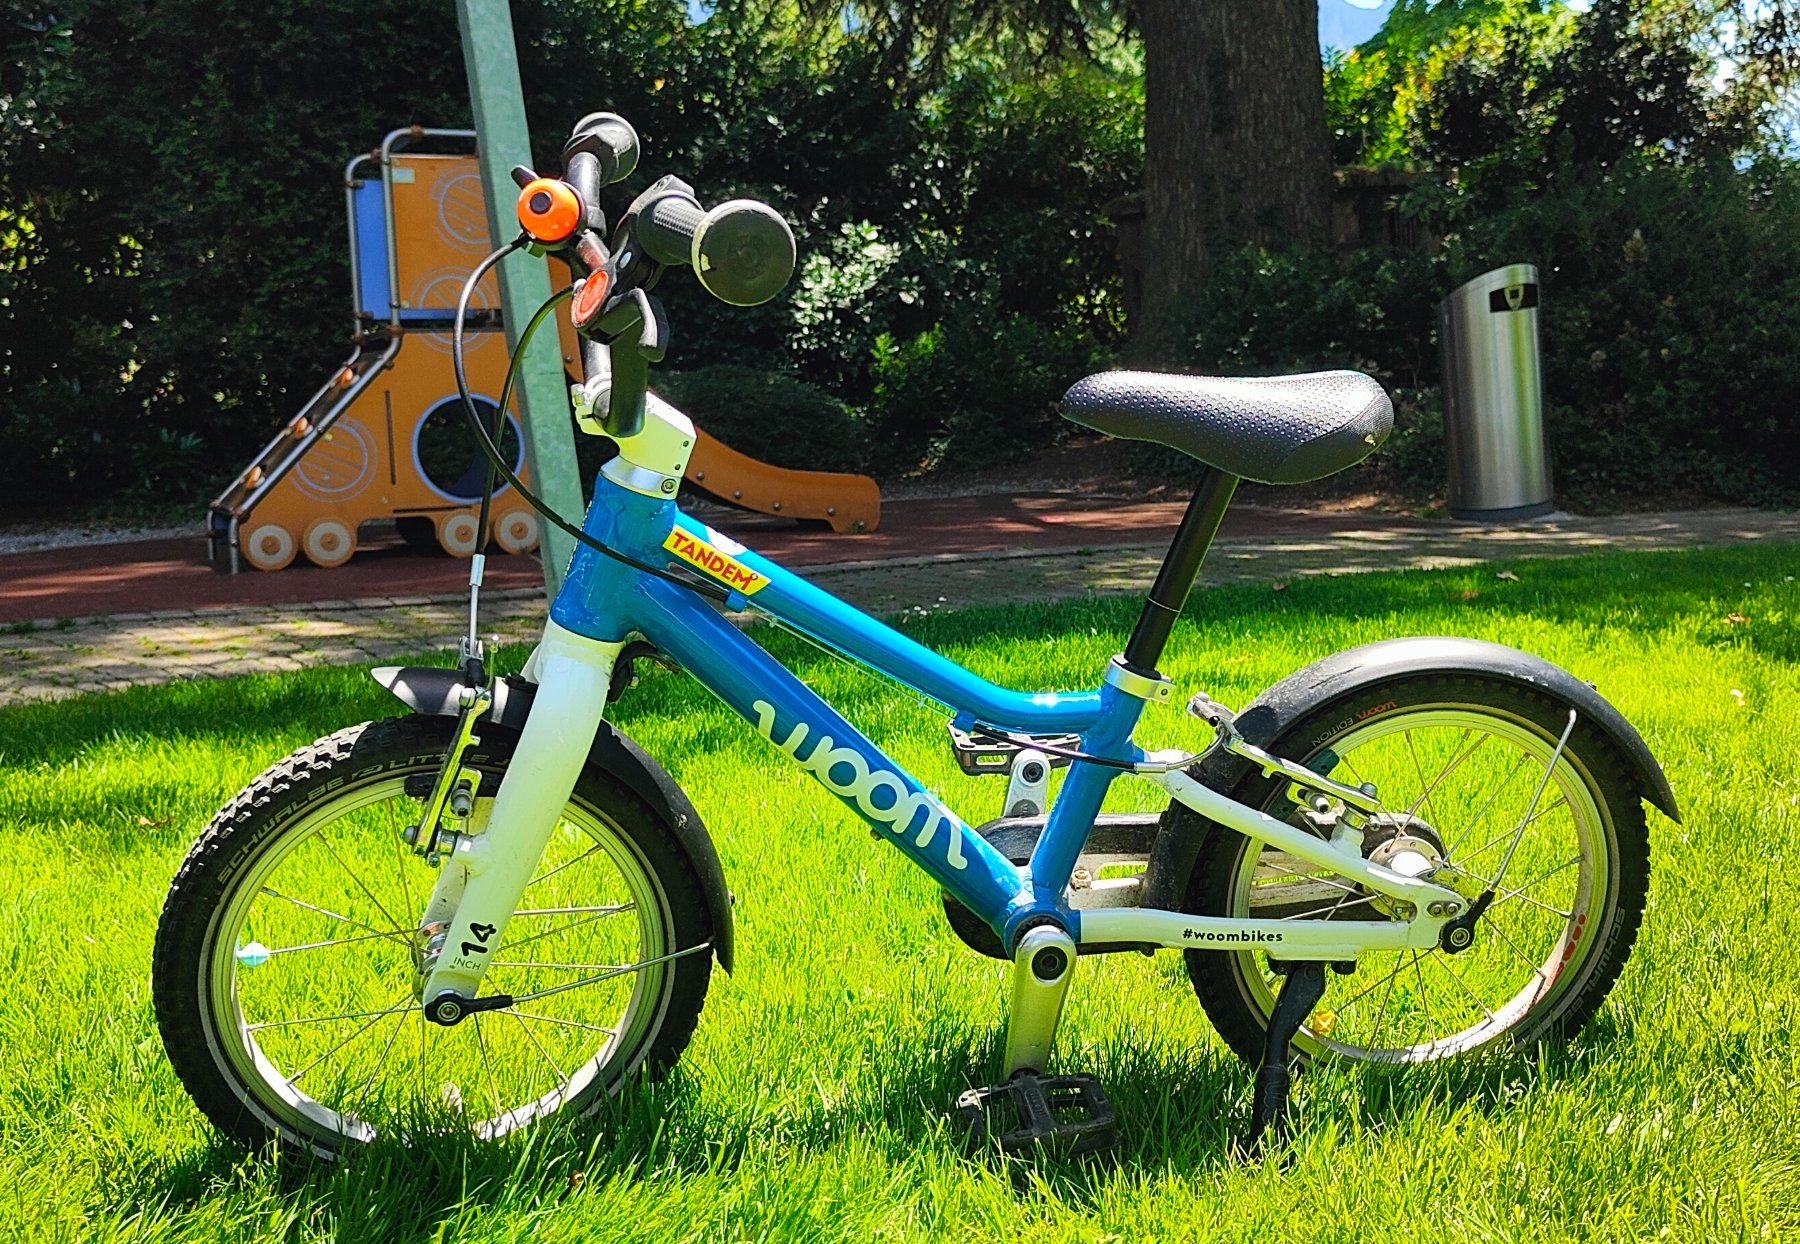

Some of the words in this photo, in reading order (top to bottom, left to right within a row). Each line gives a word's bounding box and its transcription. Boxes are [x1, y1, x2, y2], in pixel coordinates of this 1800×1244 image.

[671, 531, 758, 591] TANDEM
[1357, 700, 1398, 720] woom
[1311, 717, 1354, 747] EDITION
[752, 699, 968, 870] woom
[217, 776, 344, 884] SCHWALBE
[389, 753, 490, 770] LITTE
[461, 922, 497, 957] 14
[1182, 928, 1284, 942] #woombikes
[453, 956, 482, 971] INCH
[1562, 905, 1626, 1024] SCHWALBE
